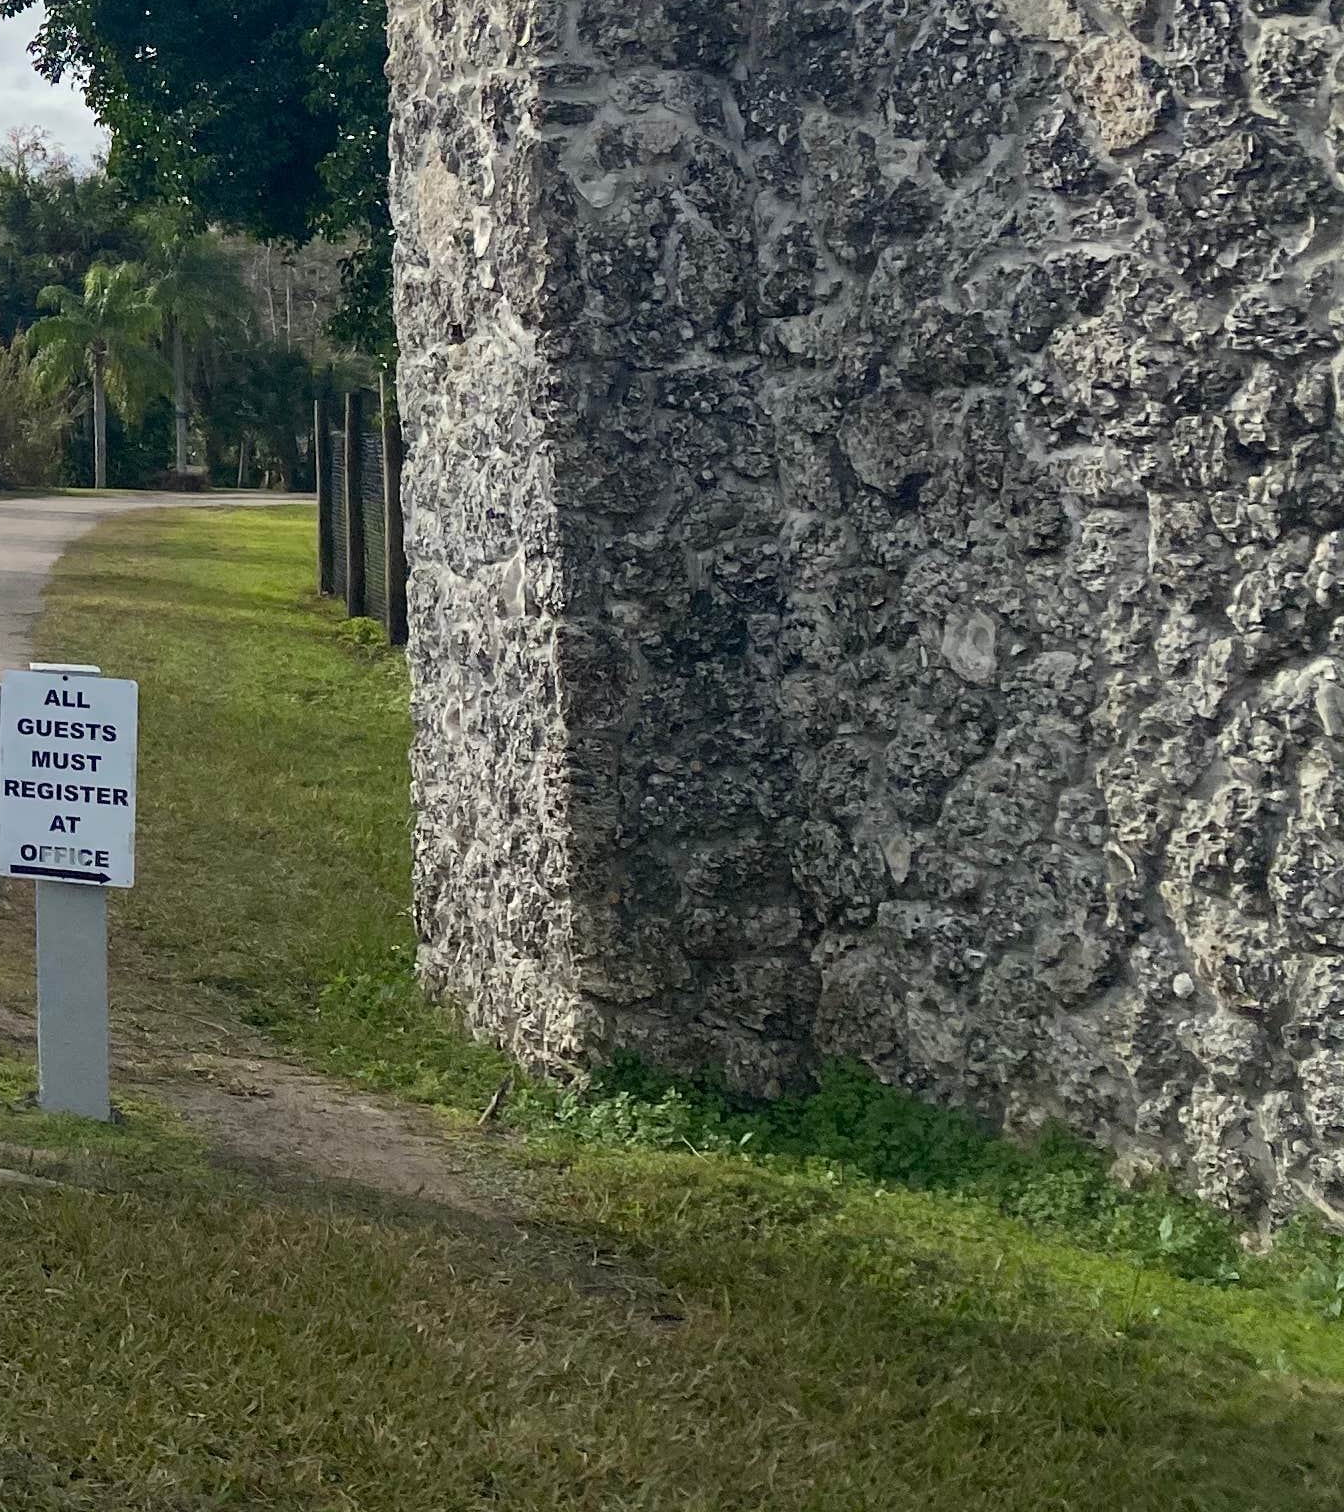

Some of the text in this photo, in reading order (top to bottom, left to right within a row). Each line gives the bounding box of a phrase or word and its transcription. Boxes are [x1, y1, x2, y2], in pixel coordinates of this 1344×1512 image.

[44, 689, 91, 709] ALL
[17, 718, 117, 742] GUESTS
[31, 750, 102, 772] MUST
[4, 779, 129, 807] REGISTER
[49, 815, 81, 834] AT
[20, 844, 110, 868] OFFICE
